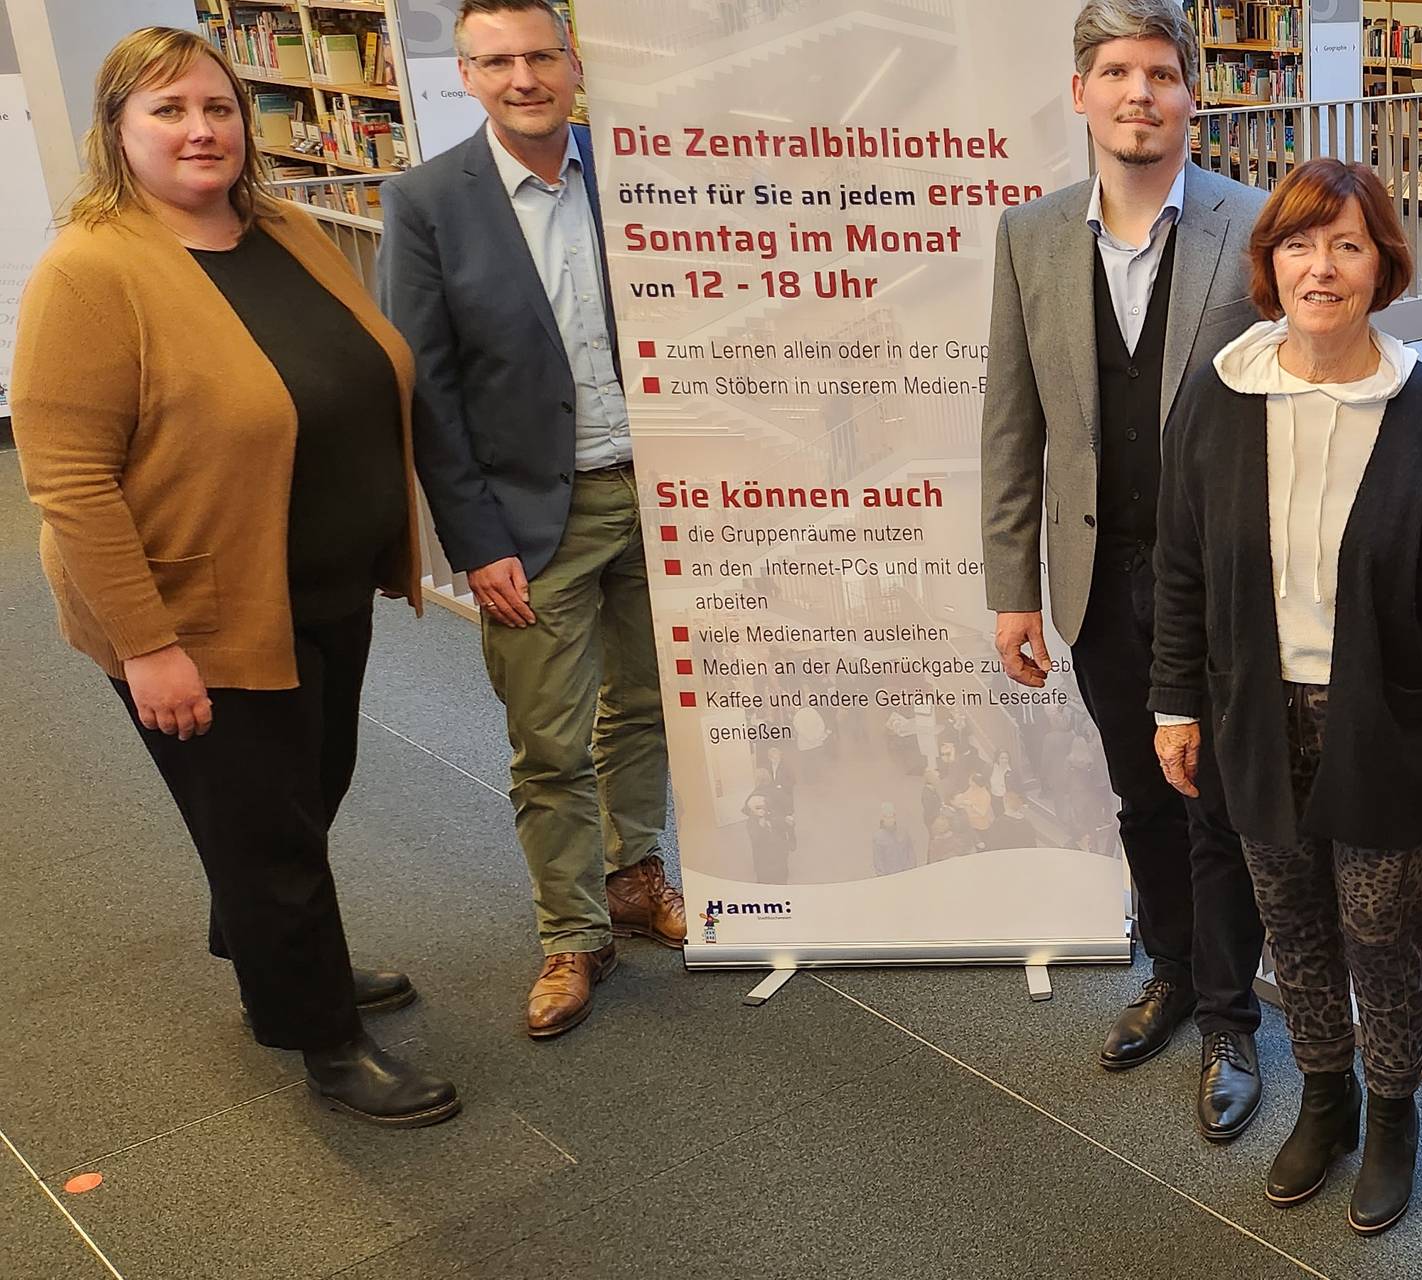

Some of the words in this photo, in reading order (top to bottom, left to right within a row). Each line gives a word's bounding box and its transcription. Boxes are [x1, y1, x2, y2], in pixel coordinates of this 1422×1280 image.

[613, 125, 671, 156] Die
[684, 127, 1008, 158] Zentralbibliothek
[619, 183, 698, 204] öffnet
[706, 184, 745, 204] für
[754, 184, 792, 205] Sie
[802, 191, 831, 205] an
[840, 184, 915, 210] jedem
[929, 180, 1042, 206] ersten
[625, 224, 777, 259] Sonntag
[789, 222, 832, 252] im
[846, 225, 961, 252] Monat
[630, 283, 675, 297] von
[685, 271, 723, 298] 12
[765, 271, 801, 298] 18
[814, 269, 878, 298] Uhr
[667, 345, 704, 358] zum
[711, 341, 776, 359] Lernen
[784, 341, 831, 359] allein
[839, 340, 880, 358] oder
[887, 340, 902, 359] in
[910, 341, 938, 358] der
[946, 341, 989, 363] Grup
[671, 381, 708, 394] zum
[716, 377, 788, 395] Stöbern
[795, 377, 810, 394] in
[818, 381, 896, 394] unserem
[657, 480, 709, 508] Sie
[721, 481, 849, 508] können
[863, 480, 942, 507] auch
[689, 525, 714, 542] die
[722, 525, 856, 546] Gruppenräume
[864, 525, 923, 542] nutzen
[692, 564, 712, 576] an
[720, 560, 752, 576] den
[766, 559, 878, 575] Internet-PCs
[886, 558, 917, 575] und
[925, 558, 951, 575] mit
[696, 593, 768, 609] arbeiten
[699, 626, 739, 643] viele
[747, 625, 856, 642] Medienarten
[864, 624, 948, 642] ausleihen
[703, 659, 767, 675] Medien
[775, 662, 795, 674] an
[803, 658, 830, 674] der
[836, 657, 974, 677] Außenrückgabe
[981, 661, 1002, 674] zu
[706, 691, 762, 708] Kaffee
[770, 690, 801, 707] und
[809, 691, 868, 706] andere
[876, 689, 955, 706] Getränke
[962, 689, 981, 705] im
[988, 688, 1067, 706] Lesecafe
[709, 723, 791, 744] genießen
[706, 900, 791, 914] Hamm:
